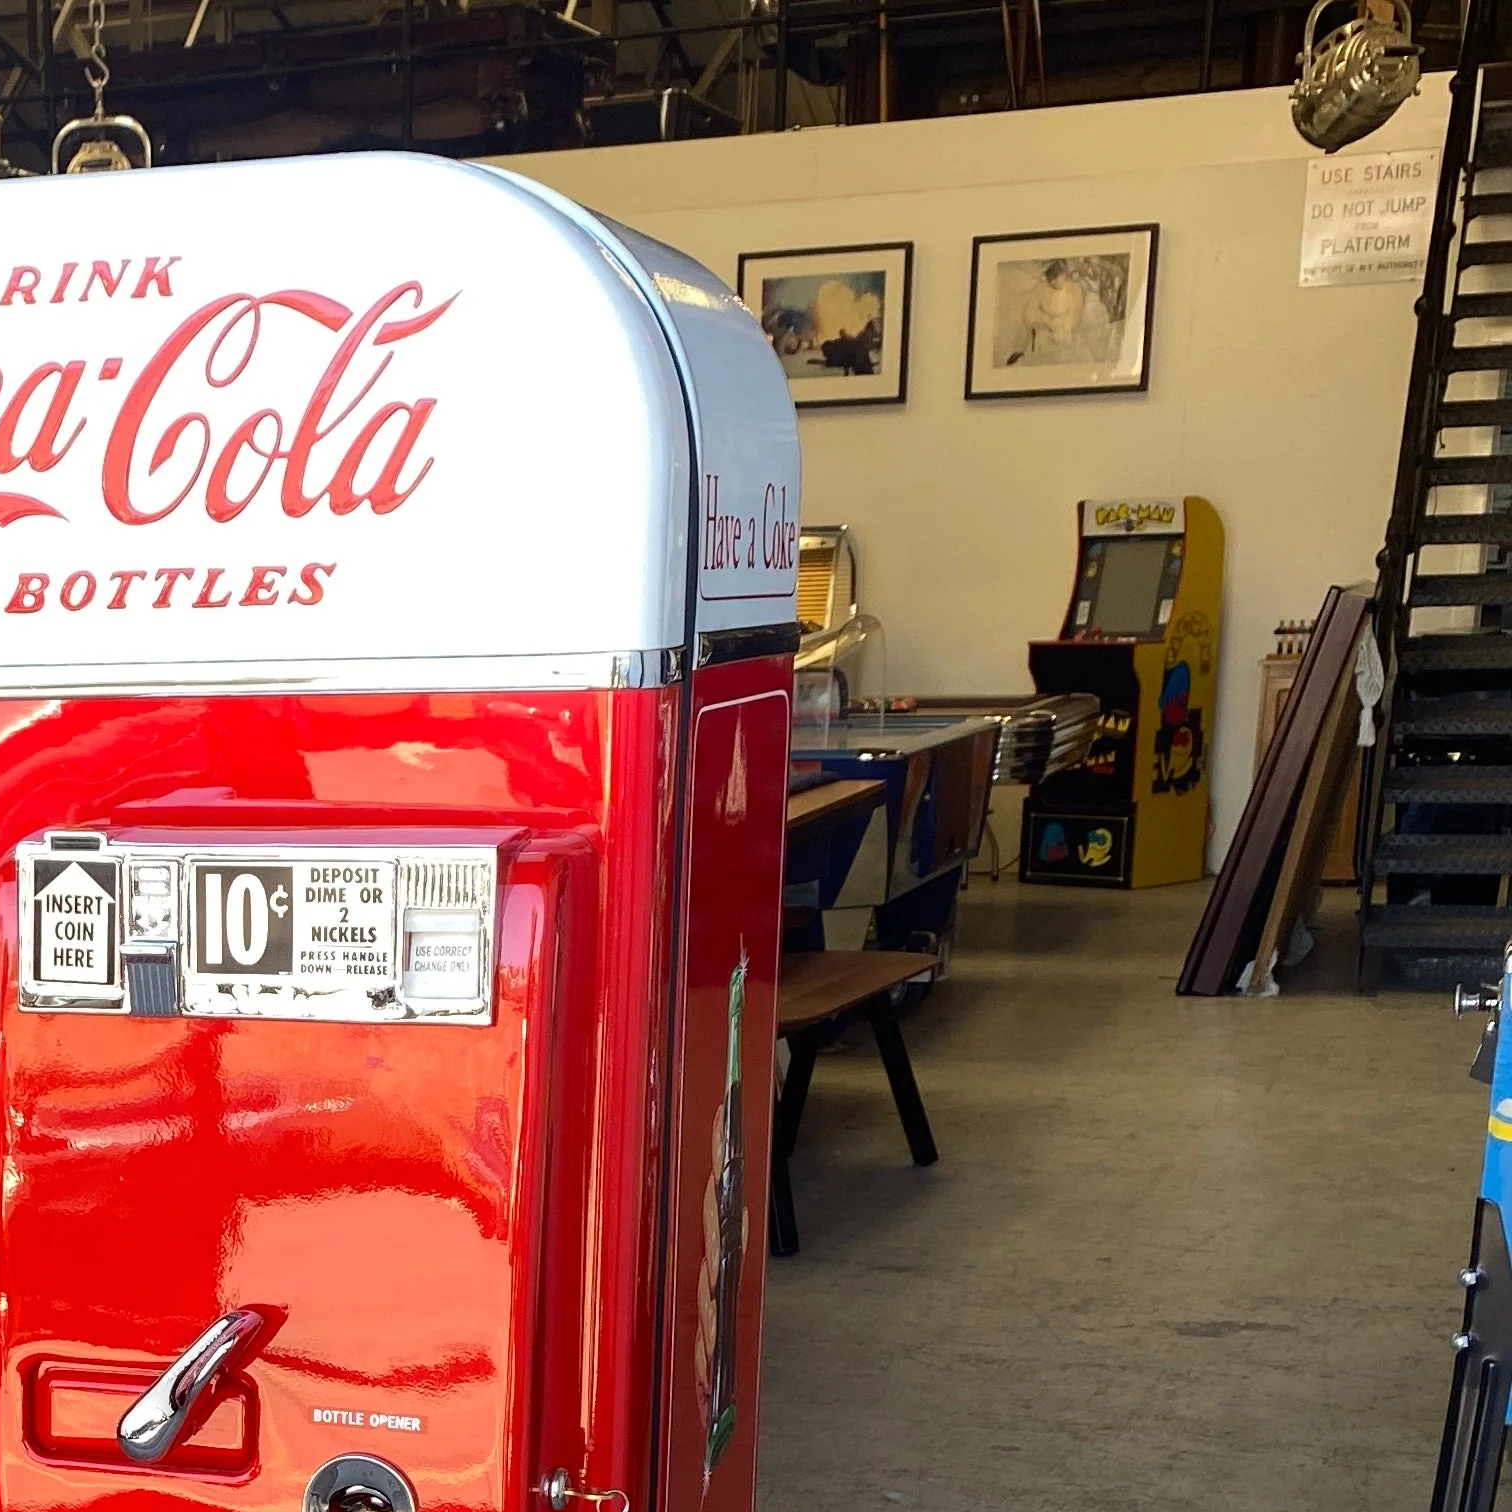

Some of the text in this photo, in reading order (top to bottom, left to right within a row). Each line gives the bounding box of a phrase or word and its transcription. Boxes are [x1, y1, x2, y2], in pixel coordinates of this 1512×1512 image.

[1321, 162, 1422, 185] USE STAIRS
[1311, 196, 1427, 220] DO NOT JUMP
[1320, 234, 1411, 256] PLATFORM
[703, 474, 796, 570] Have a Coke
[1095, 503, 1175, 526] PAC-MAN
[4, 561, 338, 615] BOTTLES
[310, 867, 380, 884] DEPOSIT
[45, 893, 104, 916] INSERT
[305, 886, 383, 904] DIME OR
[339, 907, 349, 923] 2
[54, 921, 95, 942] COIN
[311, 926, 378, 943] NICKELS
[53, 947, 95, 969] HERE
[300, 951, 388, 963] PRESS HANDLE
[415, 945, 473, 957] USE CORRECT
[414, 960, 471, 973] CHANGE ONLY
[313, 1408, 422, 1432] BOTTLE OPENER
